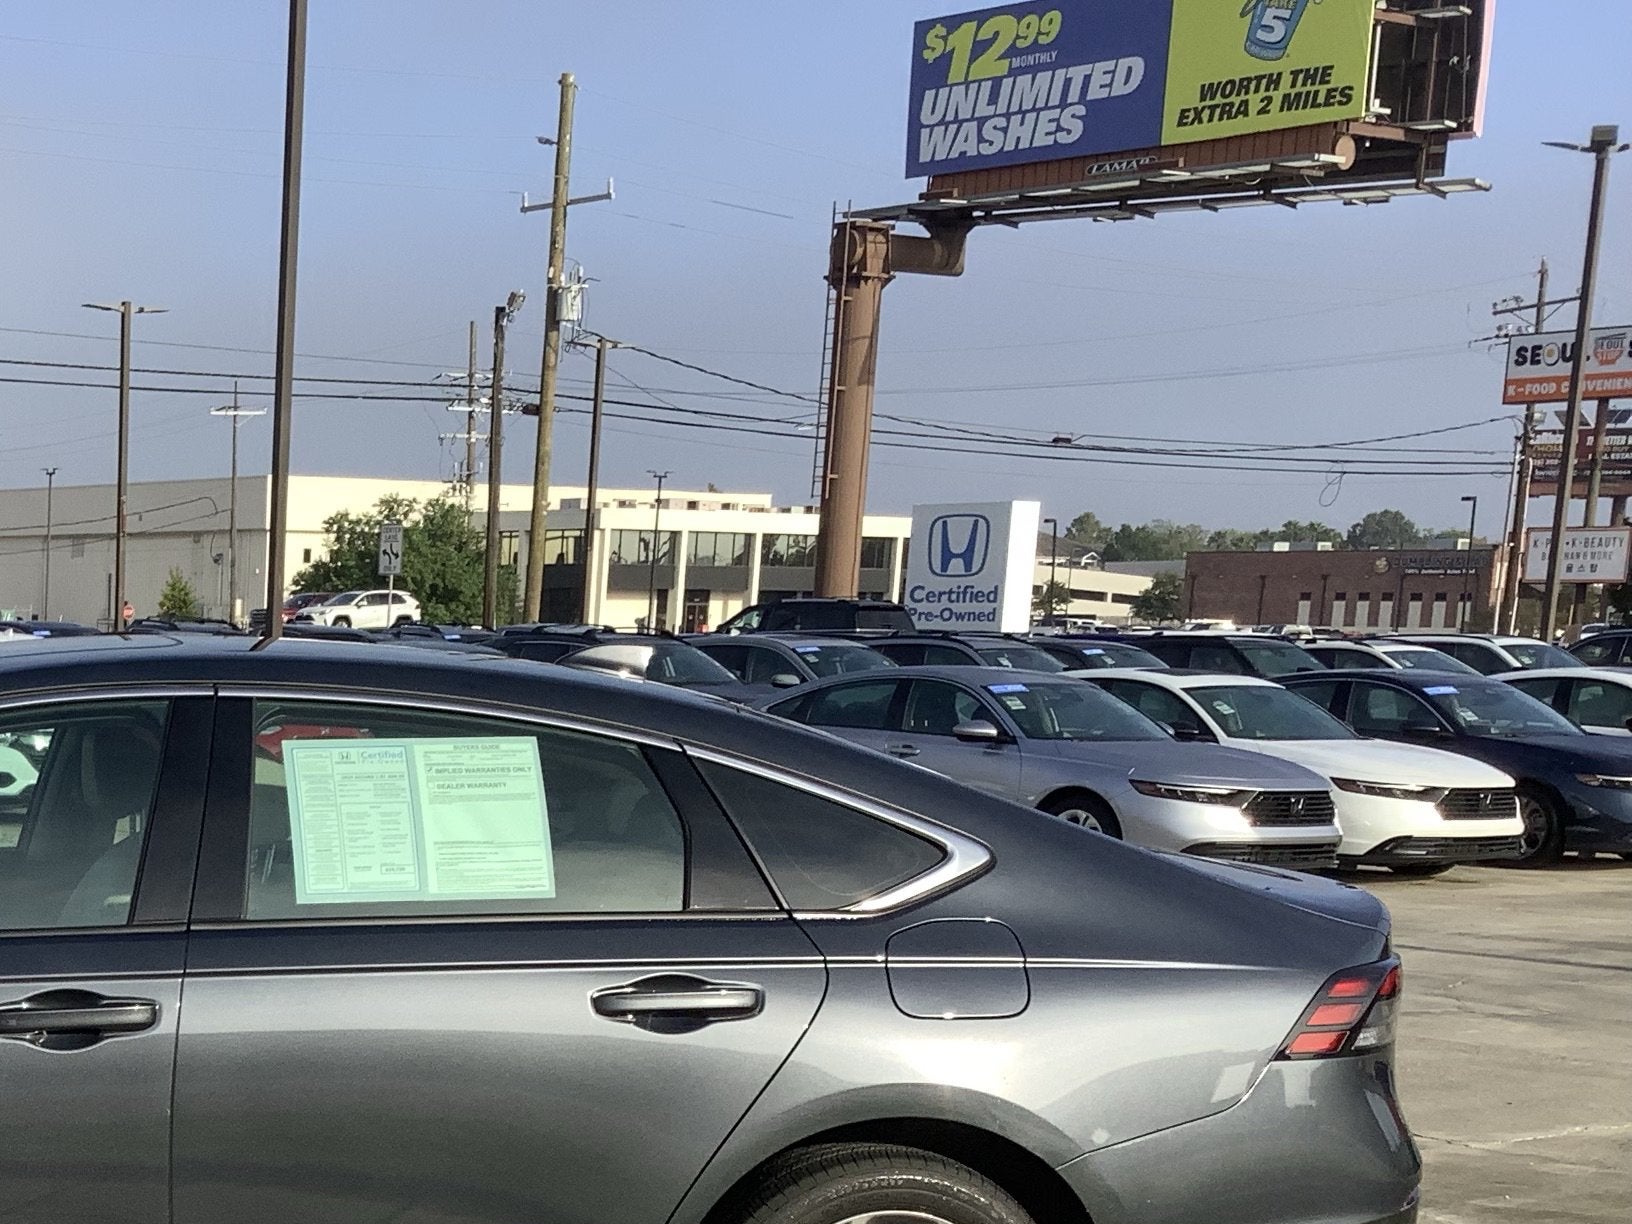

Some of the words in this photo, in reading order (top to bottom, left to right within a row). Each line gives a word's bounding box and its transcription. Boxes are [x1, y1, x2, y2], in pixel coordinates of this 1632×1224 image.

[1256, 7, 1293, 43] 5
[1011, 50, 1059, 69] MONTHLY
[920, 56, 1145, 126] UNLIMITED
[1199, 71, 1283, 103] WORTH
[1289, 64, 1335, 89] THE
[1176, 98, 1250, 128] EXTRA
[1256, 95, 1274, 116] 2
[1278, 85, 1354, 113] MILES
[919, 104, 1087, 163] WASHES
[1514, 341, 1591, 367] SEOU
[1506, 382, 1558, 397] K-FOOD
[909, 584, 999, 604] Certified
[908, 606, 997, 622] Pre-Owned
[360, 750, 404, 760] Certified
[434, 767, 464, 775] IMPLIED
[464, 766, 512, 774] WARRANTIES
[436, 782, 466, 790] DEALER
